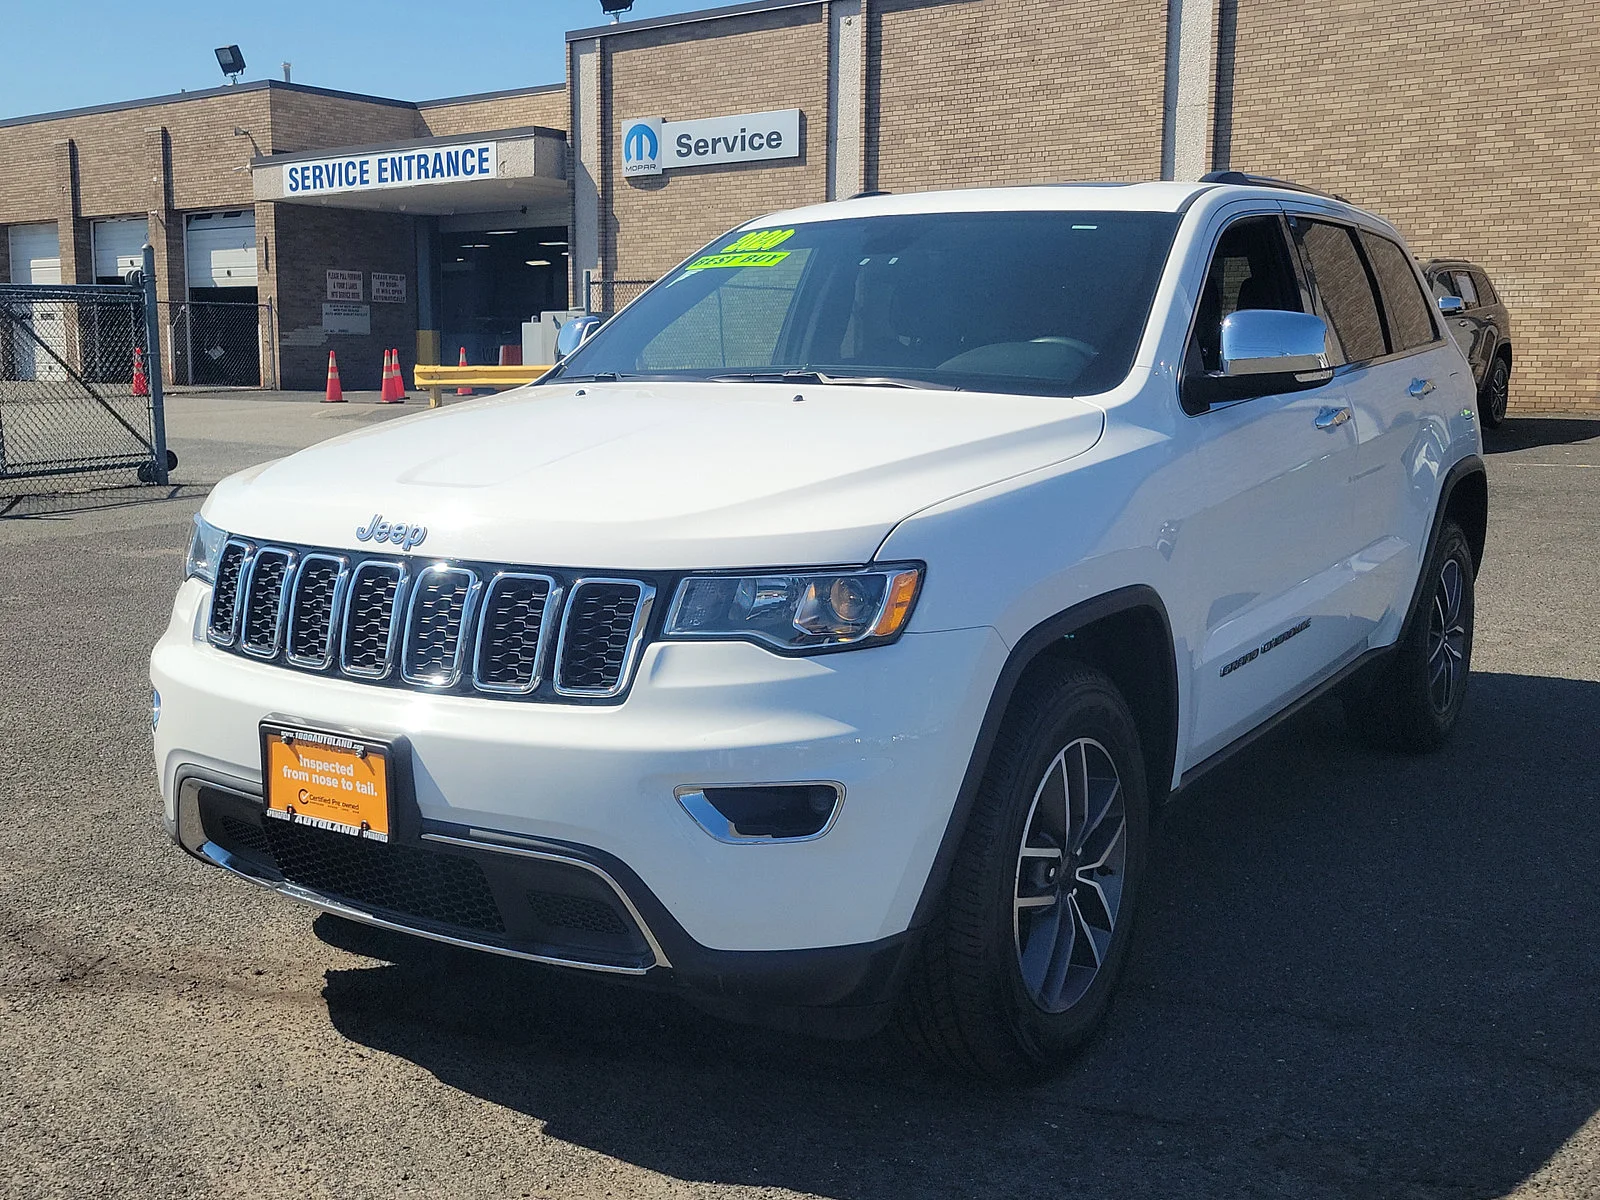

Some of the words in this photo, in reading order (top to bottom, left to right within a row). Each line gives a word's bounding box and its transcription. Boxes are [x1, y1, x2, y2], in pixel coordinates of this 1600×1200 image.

[676, 128, 782, 158] Service
[288, 160, 370, 192] SERVICE
[377, 147, 490, 184] ENTRANCE
[625, 164, 657, 172] MOPAR
[693, 255, 739, 266] BEST
[739, 254, 784, 263] BUY
[356, 514, 428, 551] Jeep
[1220, 647, 1260, 677] GRAND
[299, 754, 354, 776] Inspected
[282, 766, 309, 782] from
[312, 773, 338, 788] nose
[341, 777, 353, 791] to
[356, 780, 378, 796] tail.
[310, 794, 331, 804] Certified
[294, 814, 359, 836] AUTOLAND
